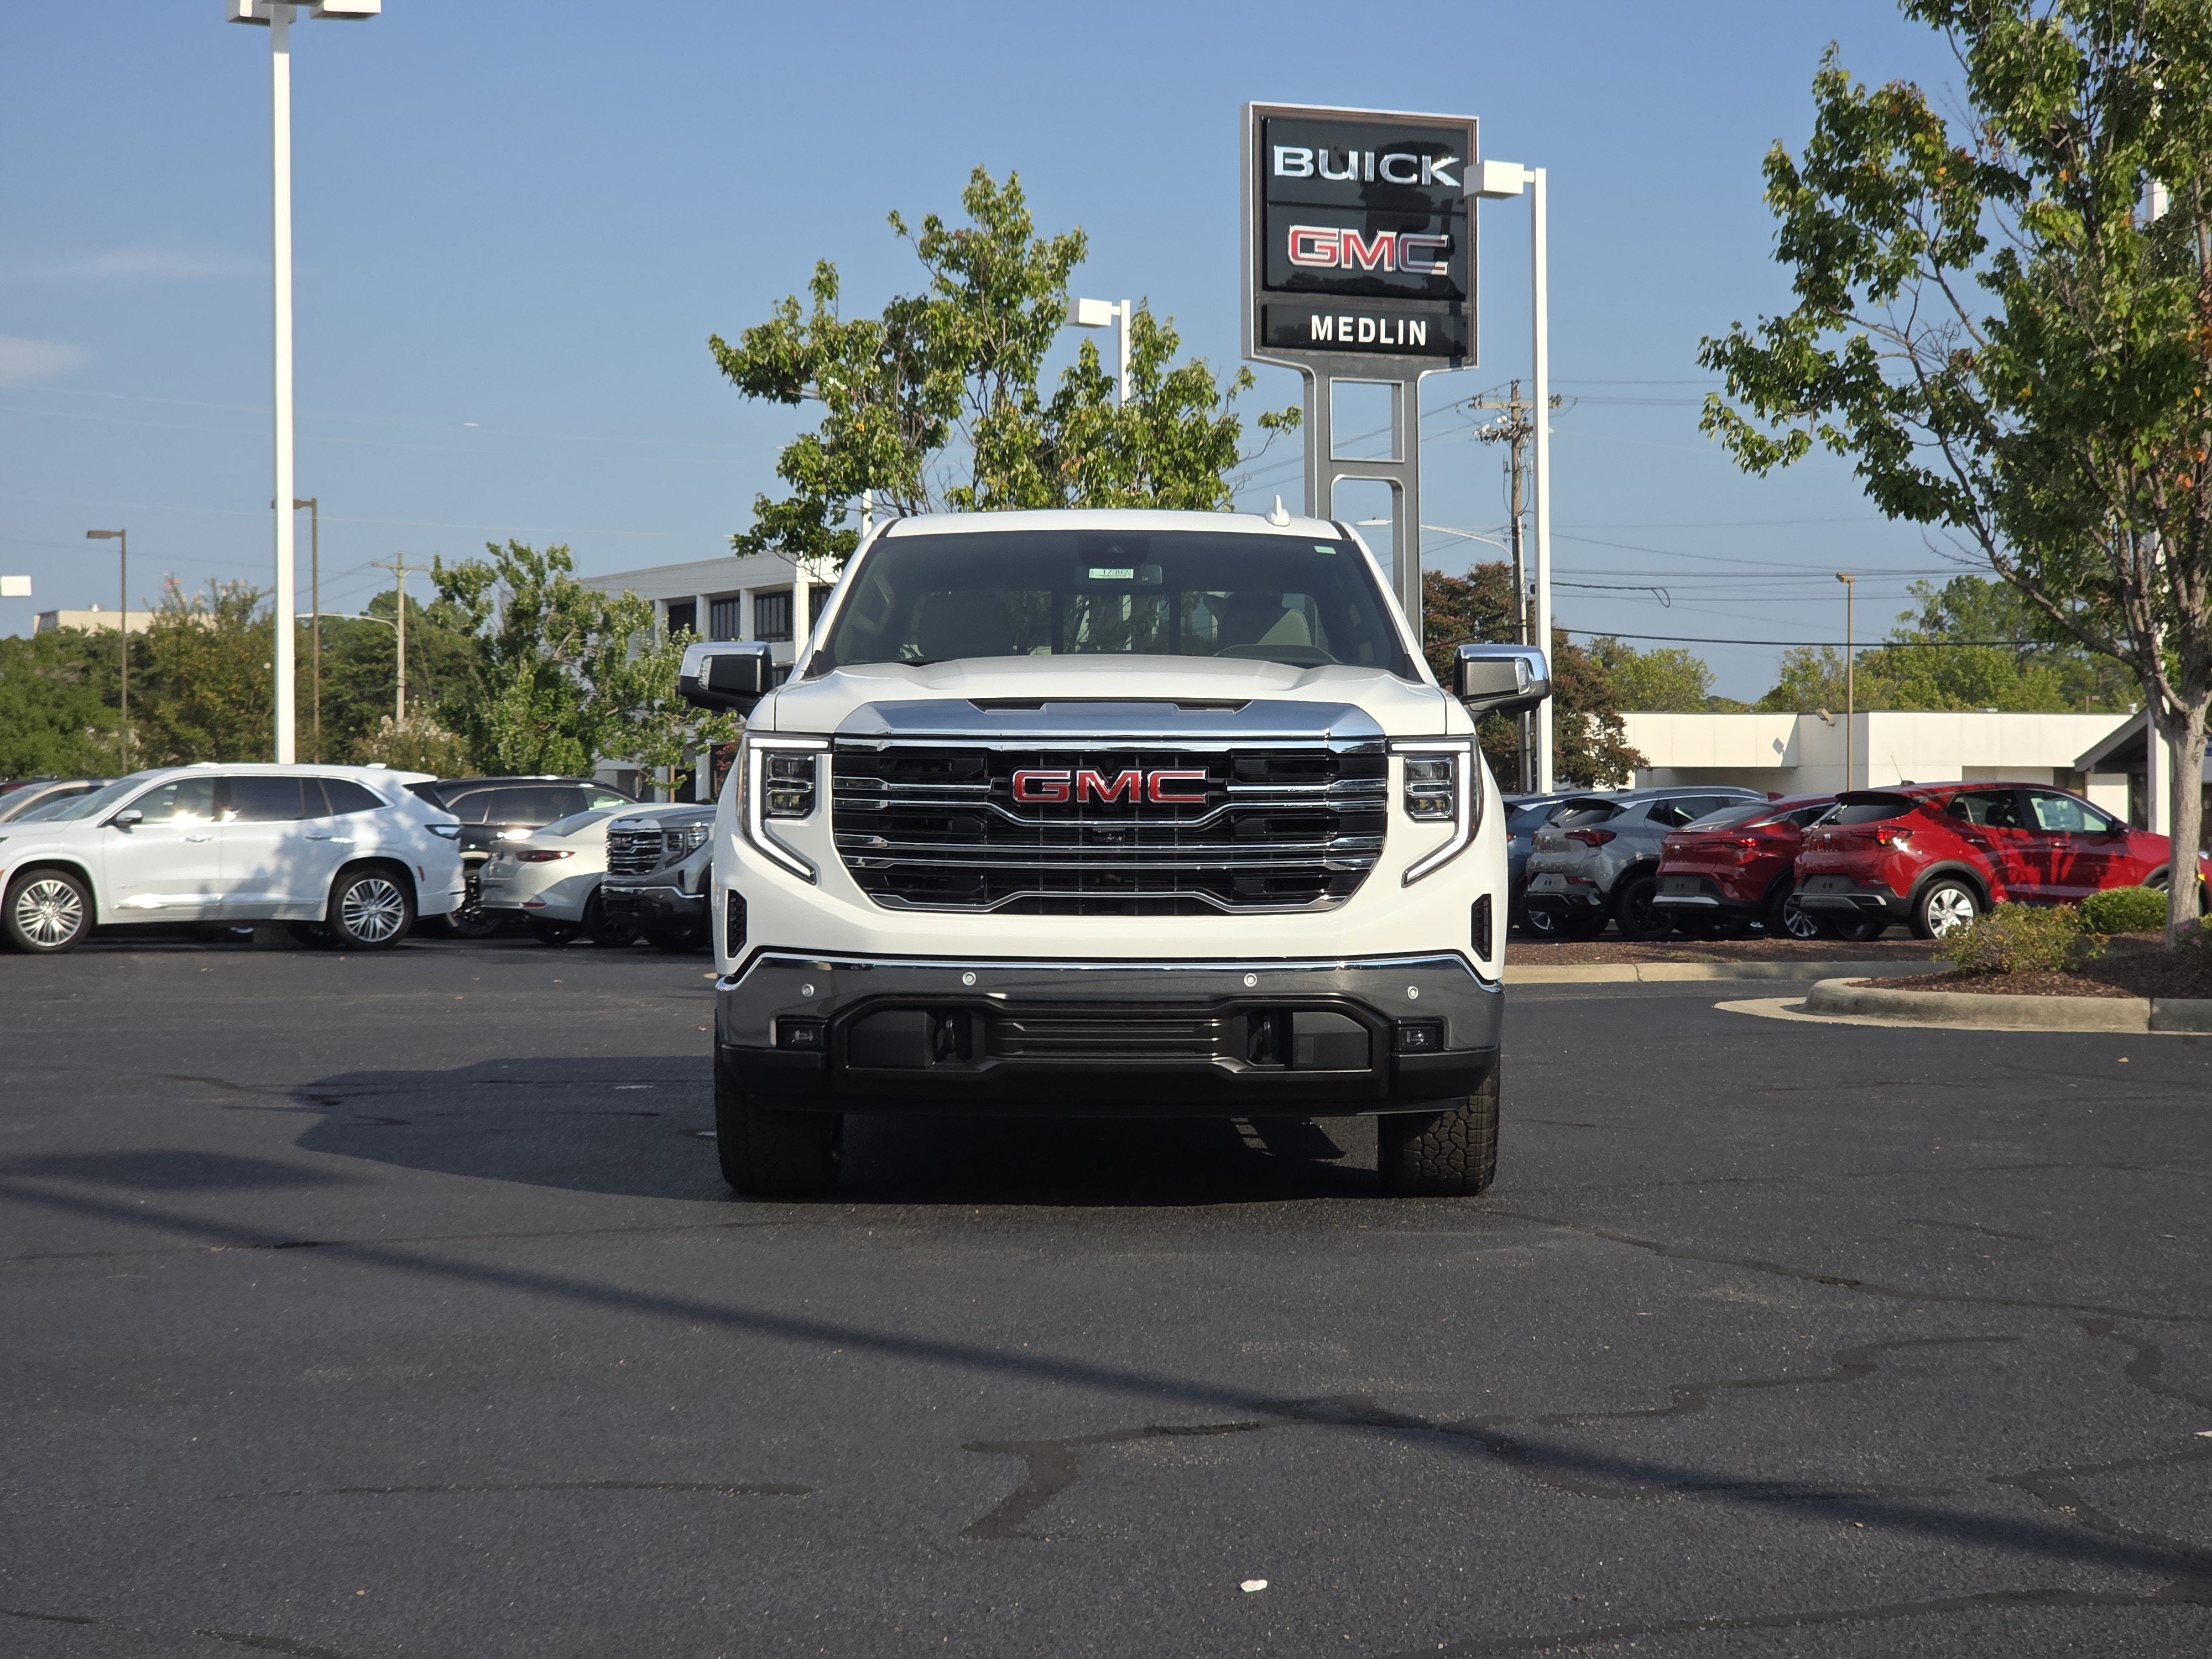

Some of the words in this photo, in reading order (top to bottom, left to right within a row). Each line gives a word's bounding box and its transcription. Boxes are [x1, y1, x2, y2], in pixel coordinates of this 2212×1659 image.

[1274, 145, 1461, 187] BUICK
[1288, 226, 1448, 275] GMC
[1311, 316, 1426, 346] MEDLIN
[1013, 770, 1207, 804] GMC
